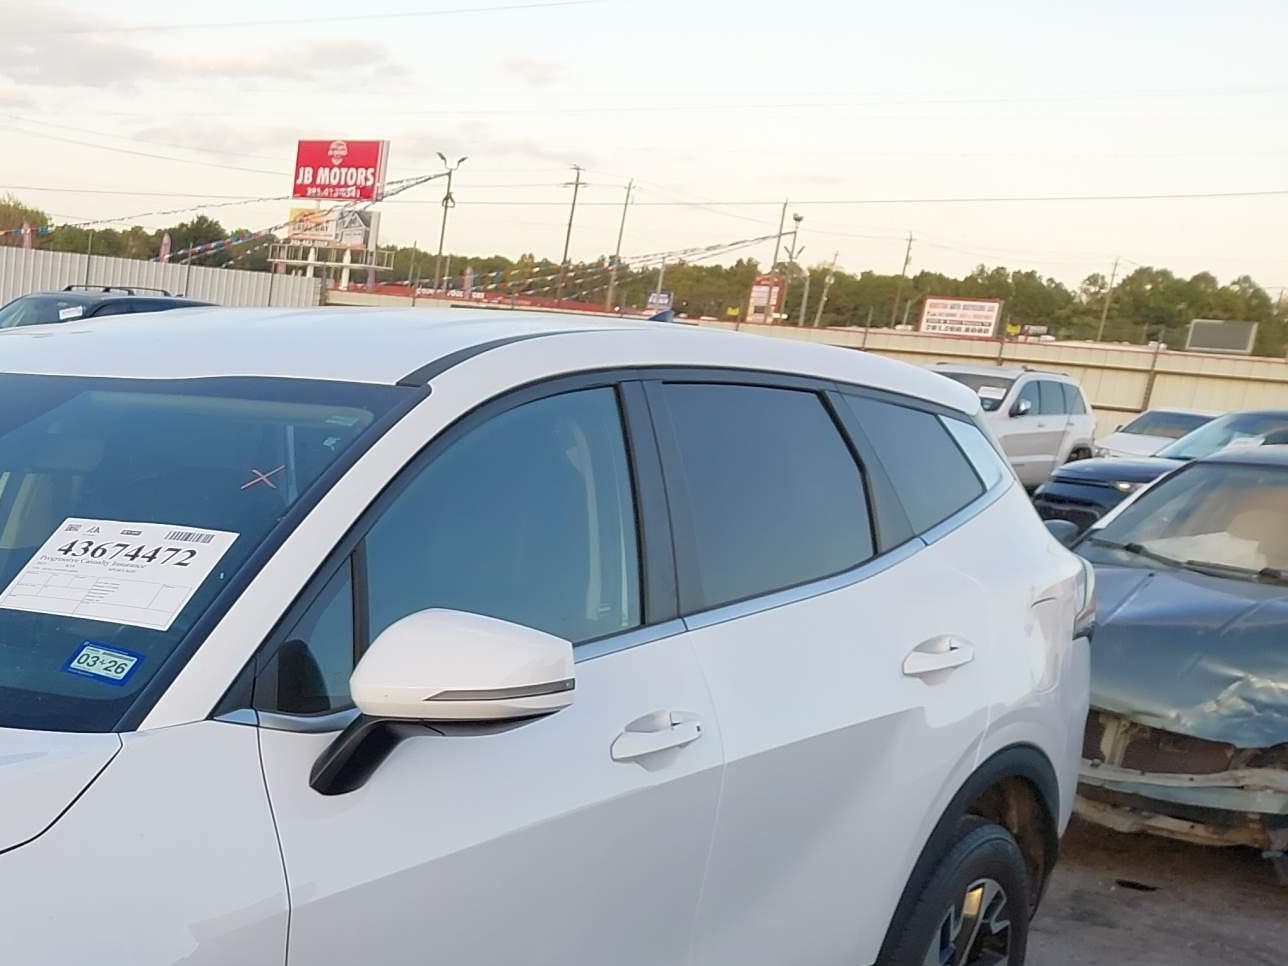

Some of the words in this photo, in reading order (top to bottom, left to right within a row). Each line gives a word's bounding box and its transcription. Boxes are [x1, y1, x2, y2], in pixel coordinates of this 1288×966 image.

[296, 167, 314, 185] JB
[316, 167, 375, 186] MOTORS
[57, 539, 197, 567] 43674472
